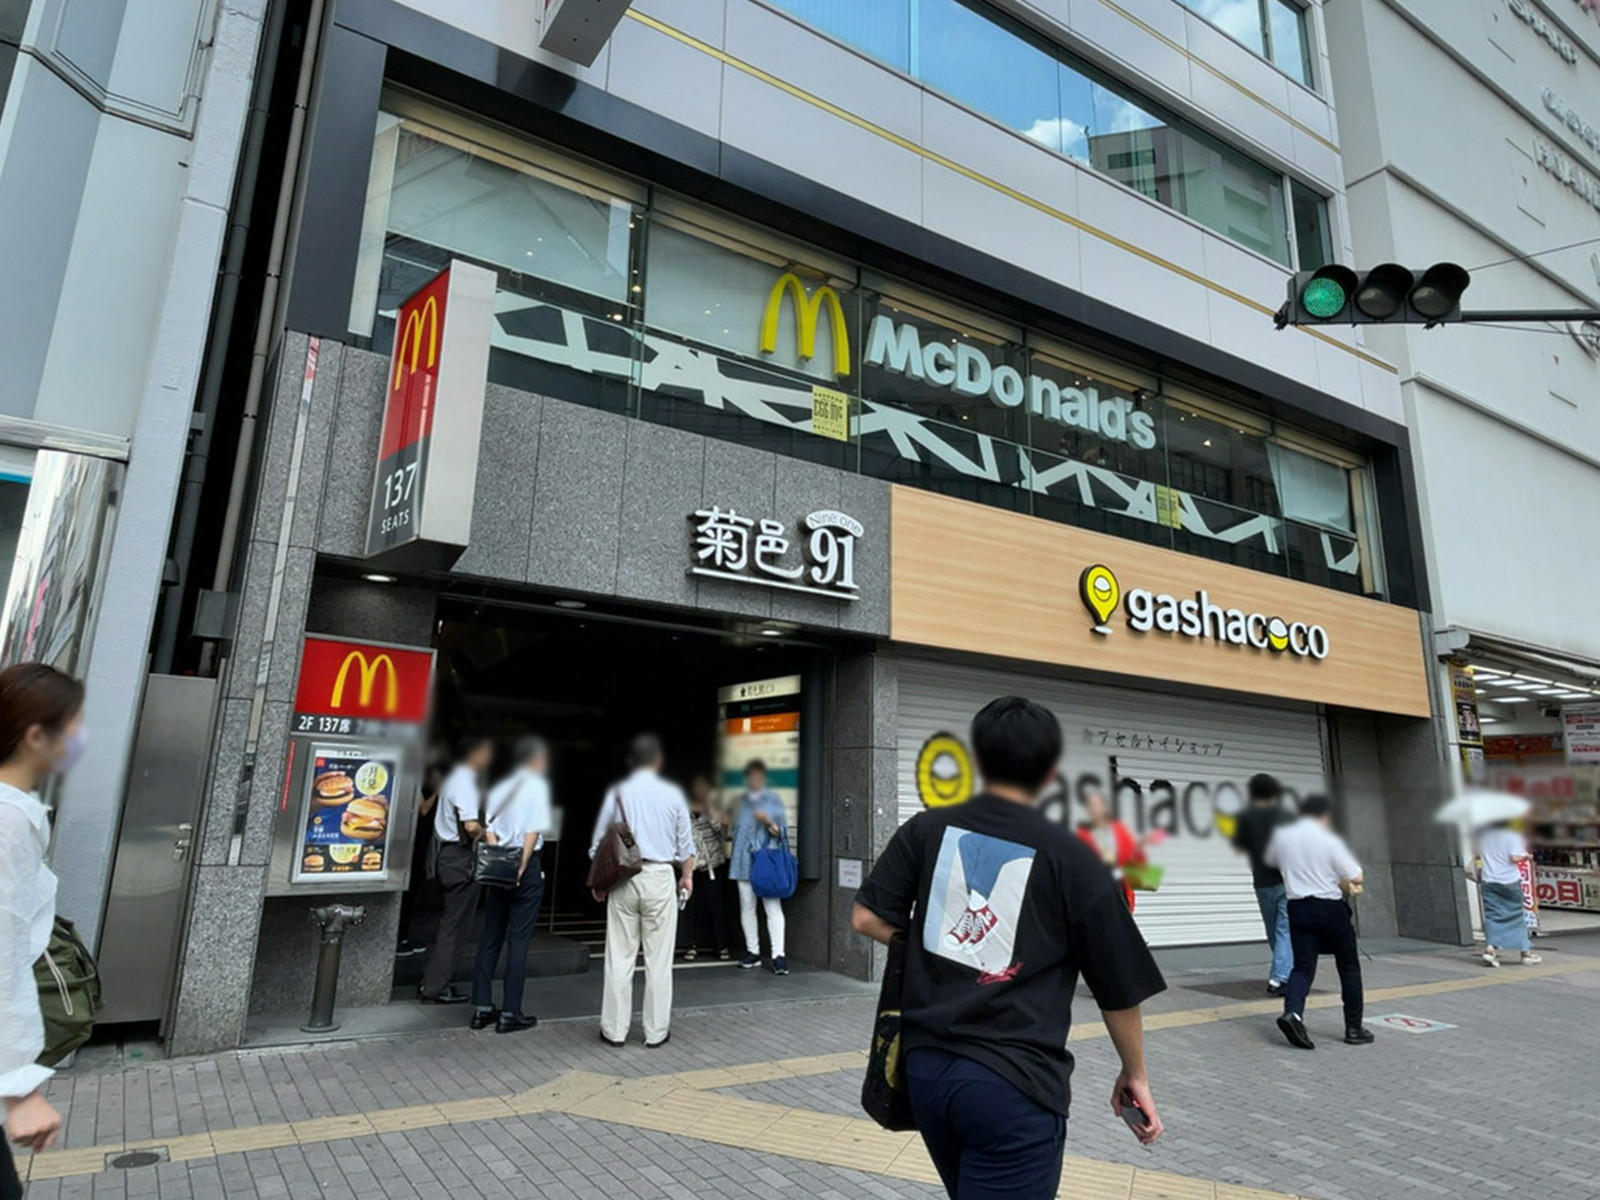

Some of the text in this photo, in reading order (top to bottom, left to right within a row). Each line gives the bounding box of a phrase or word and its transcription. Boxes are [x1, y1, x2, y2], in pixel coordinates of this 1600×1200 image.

[864, 314, 1157, 450] McDonald's
[383, 462, 418, 510] 137
[380, 509, 410, 534] SEATS
[808, 512, 863, 535] Nine one
[695, 505, 860, 589] 菊邑 91
[1125, 589, 1330, 660] gashacoco
[298, 715, 315, 731] 2F
[1083, 728, 1223, 756] プセルトイショップ
